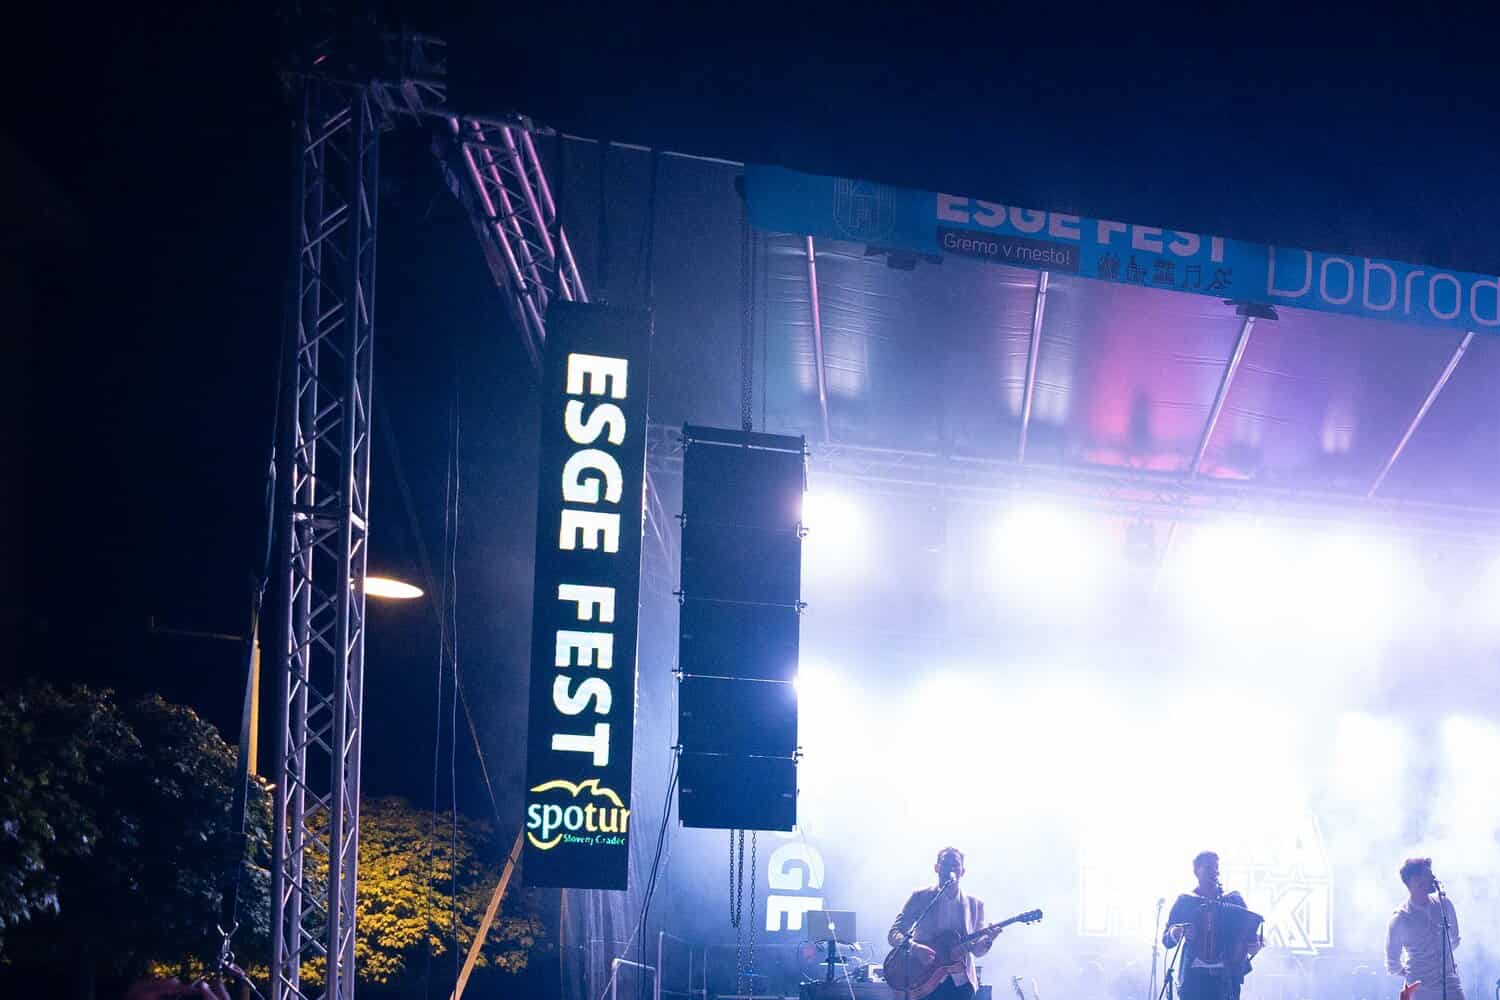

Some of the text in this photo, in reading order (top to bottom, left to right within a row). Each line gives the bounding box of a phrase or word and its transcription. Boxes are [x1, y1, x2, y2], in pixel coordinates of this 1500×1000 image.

[944, 232, 1071, 265] Gremo v mesto!
[551, 352, 629, 767] ESGE FEST
[526, 802, 631, 840] spotur
